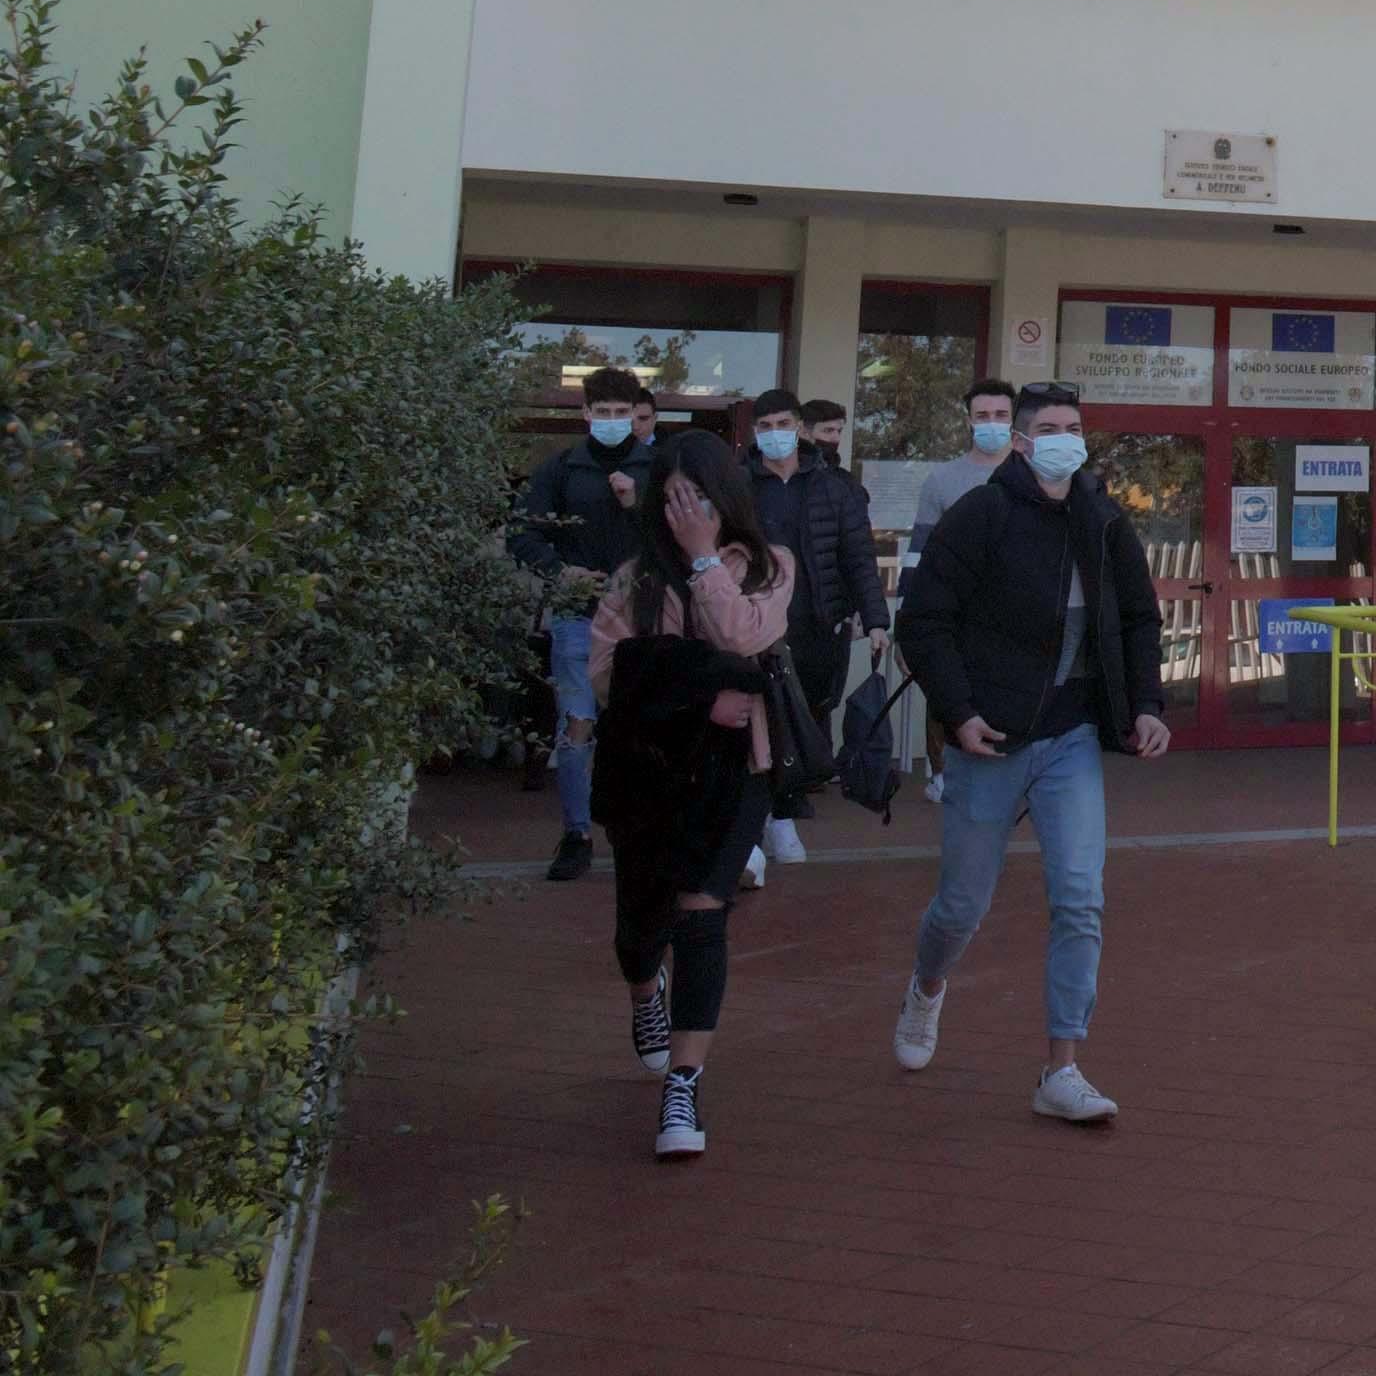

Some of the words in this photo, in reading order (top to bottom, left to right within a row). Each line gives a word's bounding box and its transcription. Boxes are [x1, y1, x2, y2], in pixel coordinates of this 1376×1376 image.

[1208, 182, 1246, 194] DEFFENU
[1089, 352, 1128, 364] FONDO
[1075, 365, 1130, 377] SVILUPPO
[1135, 366, 1197, 379] REGIONALE
[1235, 362, 1271, 373] FONDO
[1275, 363, 1316, 375] SOCIALE
[1320, 365, 1369, 376] EUROPEO
[1302, 460, 1363, 477] ENTRATA
[1267, 620, 1328, 635] ENTRATA
